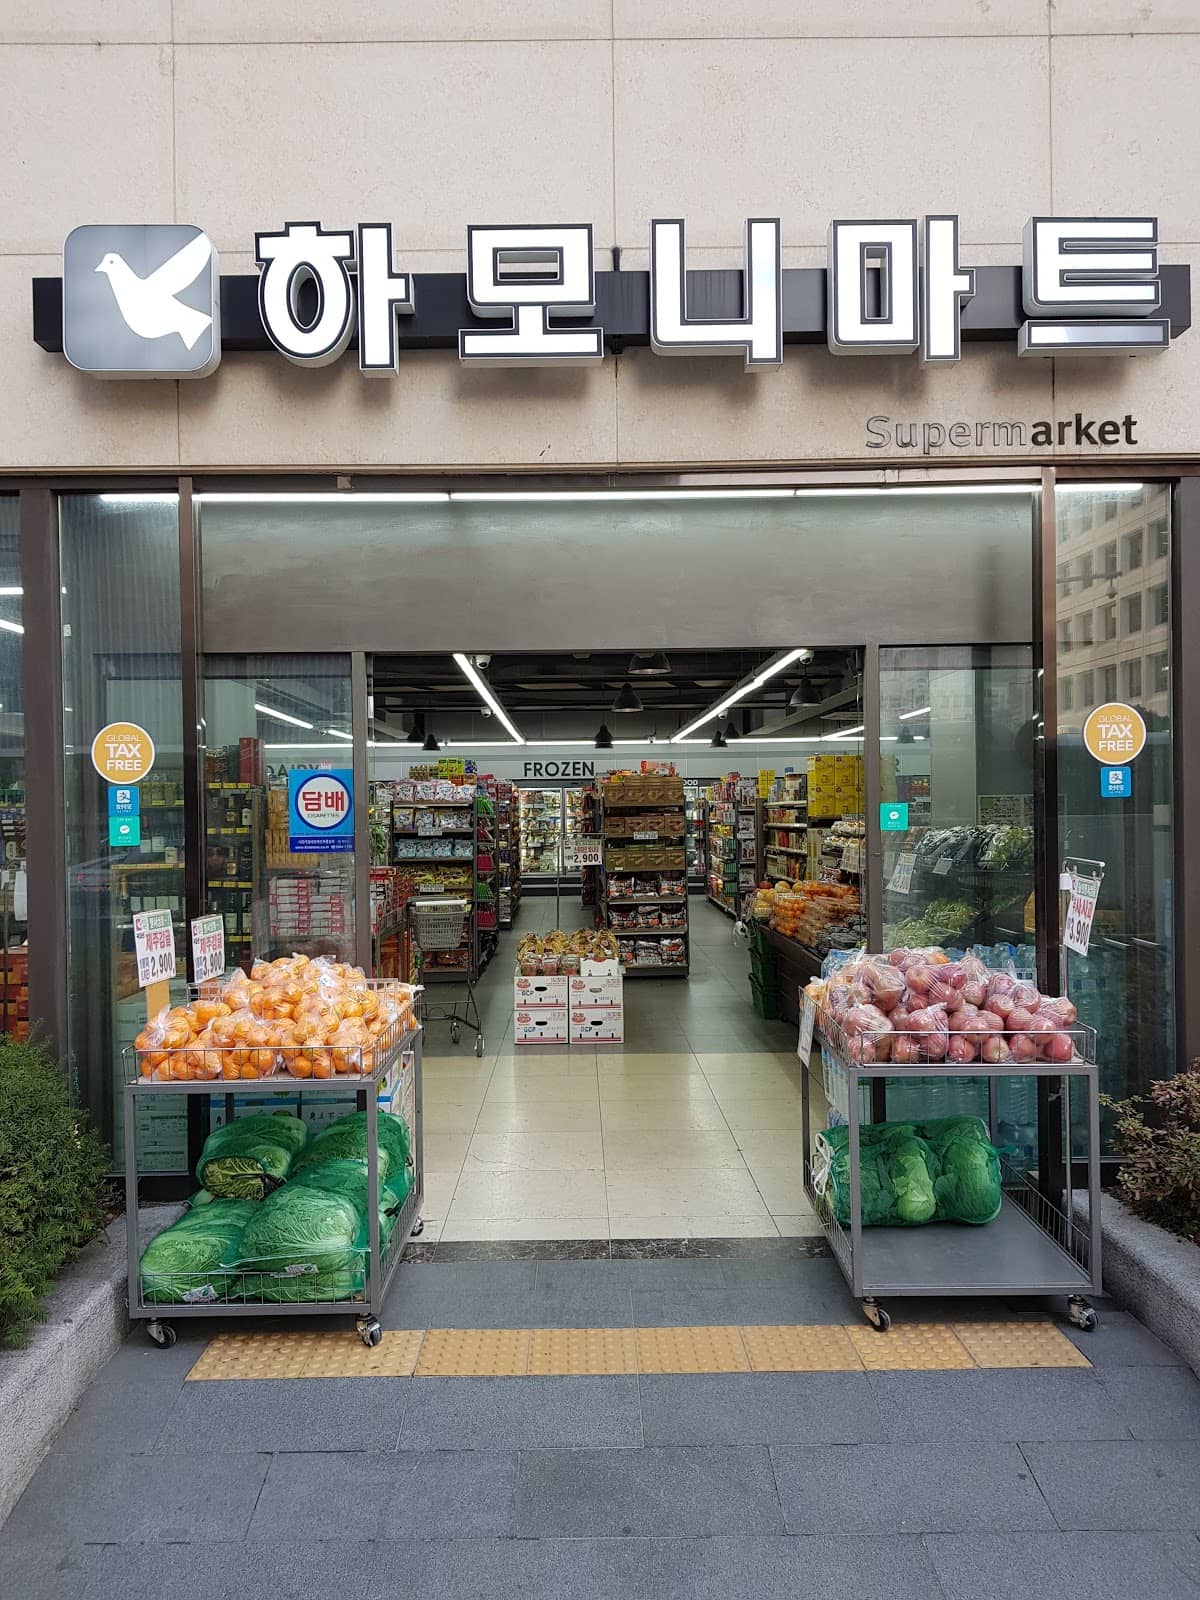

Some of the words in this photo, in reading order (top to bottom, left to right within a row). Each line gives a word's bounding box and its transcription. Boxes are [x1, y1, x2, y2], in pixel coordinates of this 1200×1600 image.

[255, 214, 1171, 372] 하모니마트
[865, 413, 1138, 455] Supermarket
[106, 734, 143, 742] GLOBAL
[1096, 724, 1134, 739] TAX
[104, 743, 142, 759] TAX
[1098, 740, 1134, 752] FREE
[106, 759, 143, 772] FREE
[524, 761, 595, 777] FROZEN
[302, 791, 345, 812] 담배
